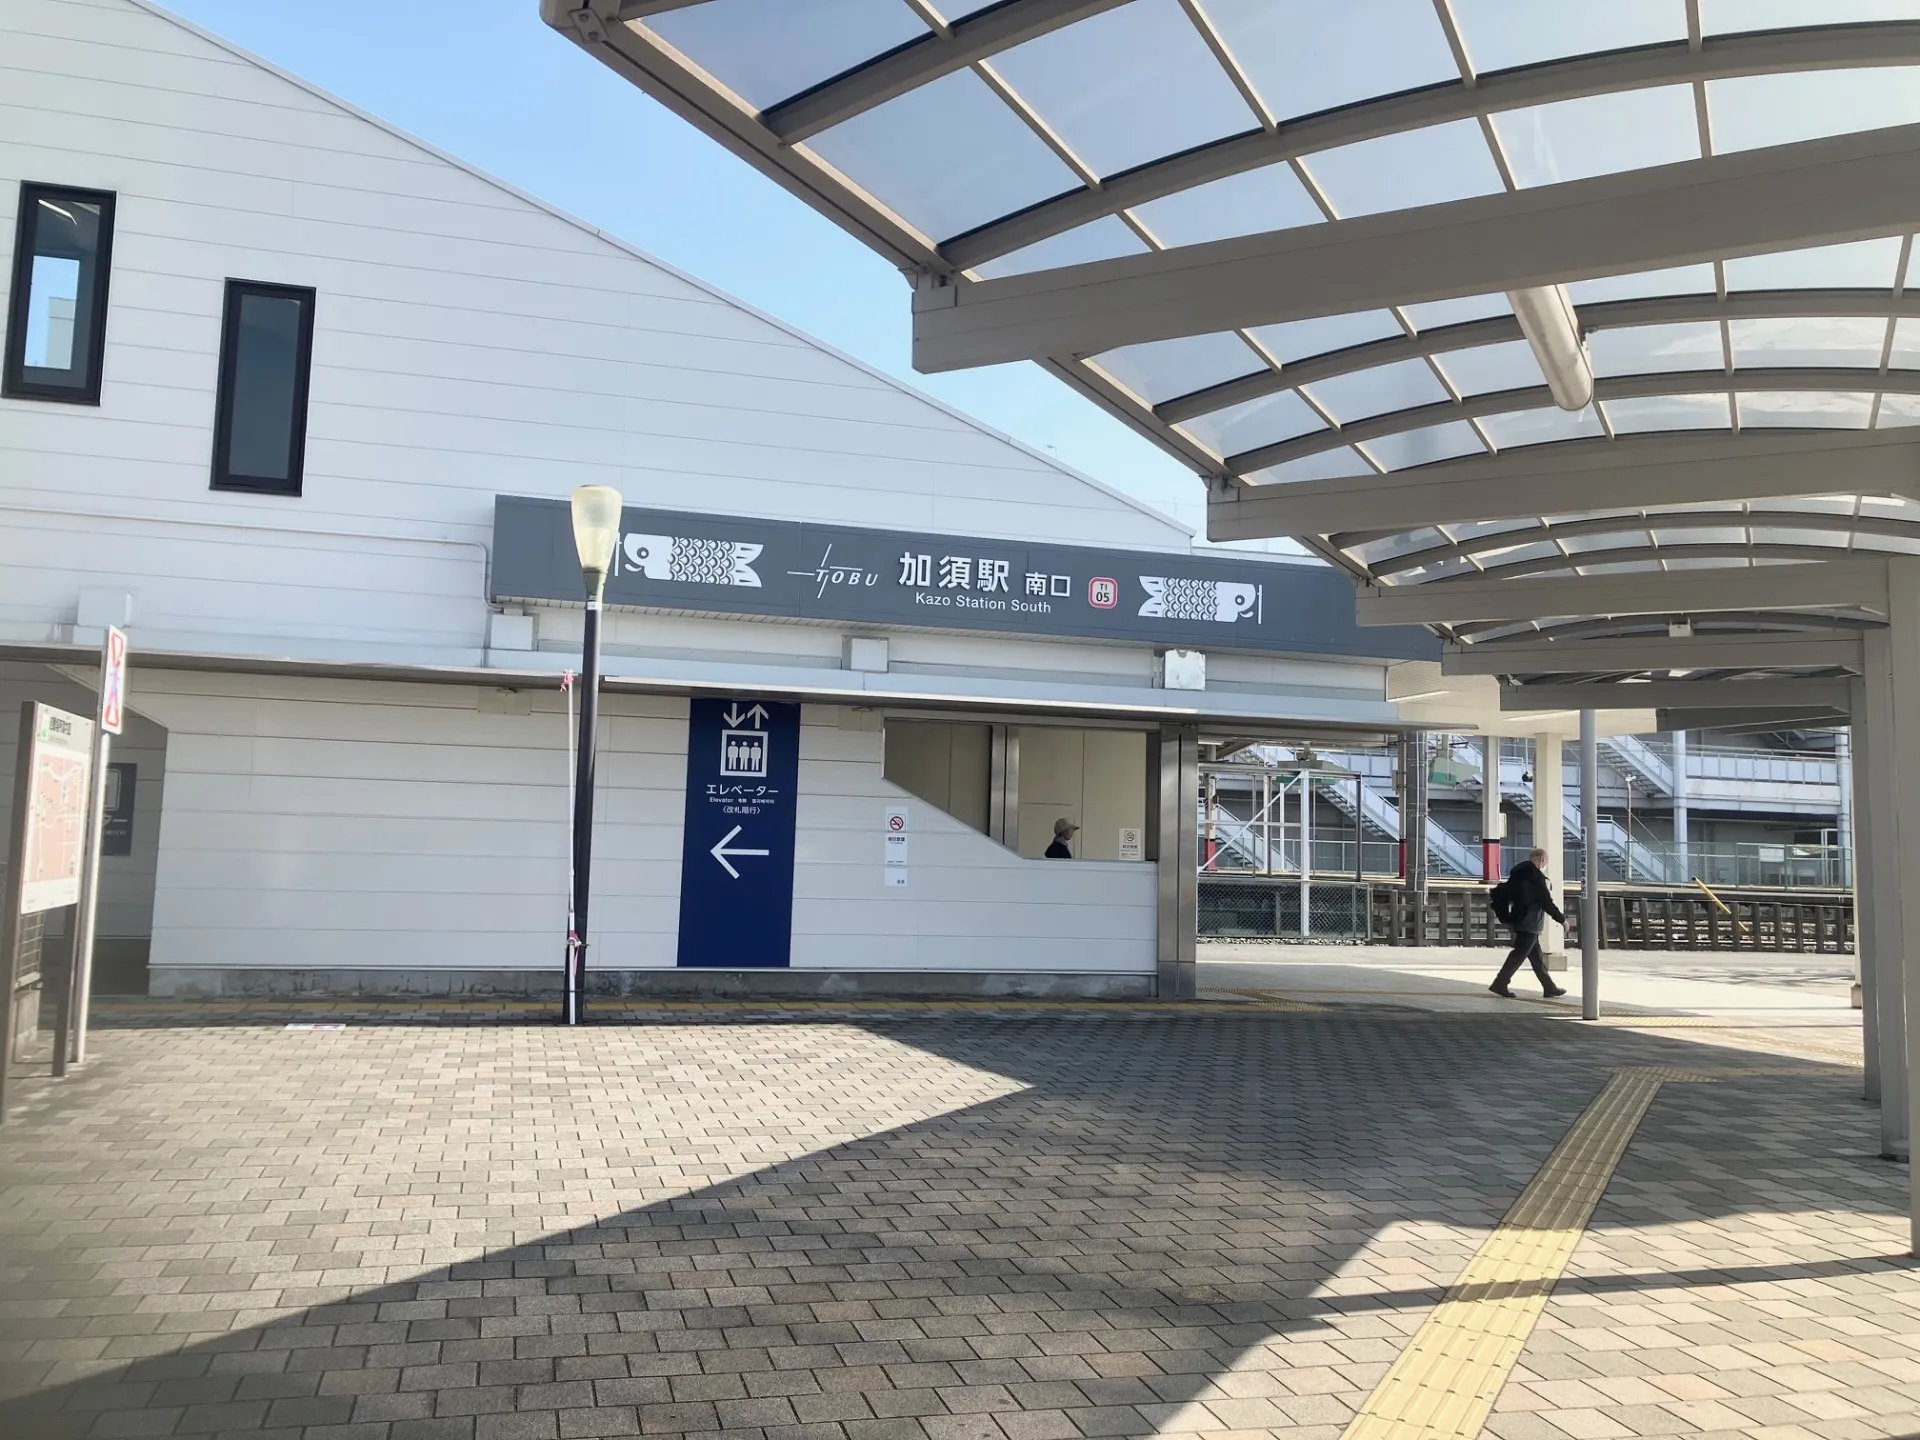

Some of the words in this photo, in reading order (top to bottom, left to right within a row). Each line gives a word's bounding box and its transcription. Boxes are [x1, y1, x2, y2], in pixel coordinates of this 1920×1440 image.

[898, 551, 1010, 593] 加須駅
[1024, 571, 1071, 597] 南口
[915, 591, 951, 606] Kazo
[955, 594, 1006, 610] Station
[1010, 599, 1051, 613] South
[1096, 591, 1110, 603] 05
[706, 784, 779, 796] エレベーター
